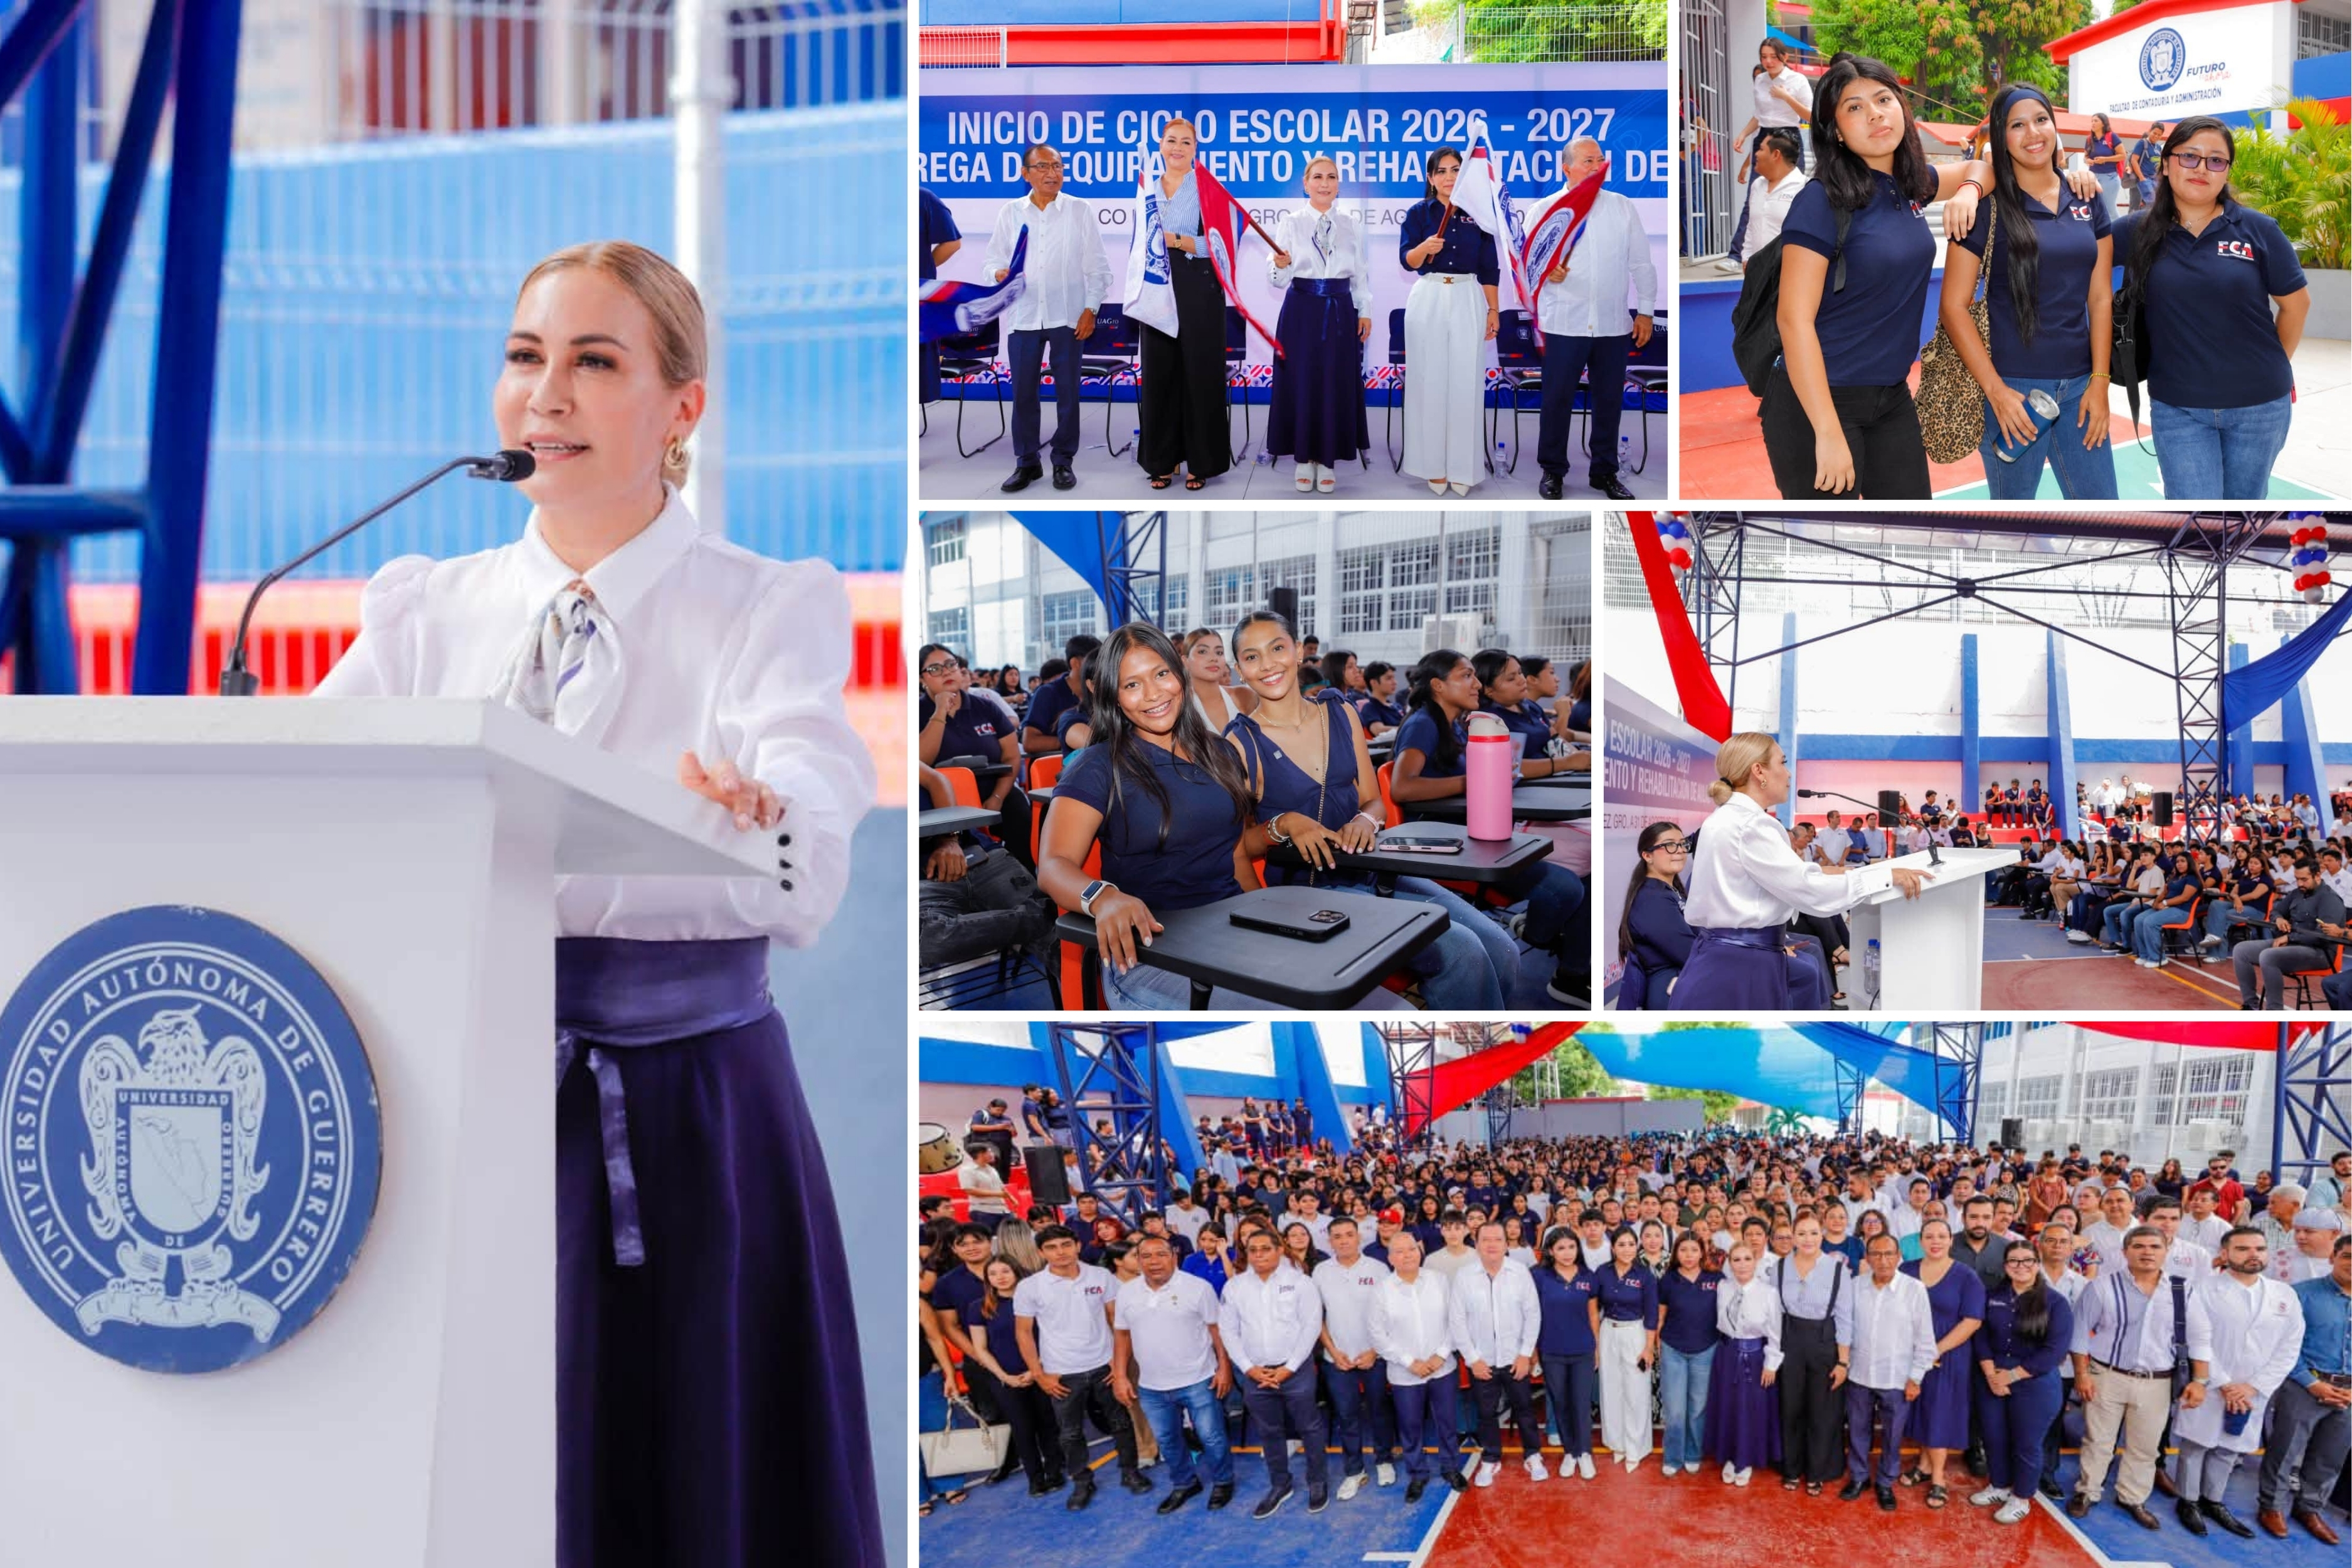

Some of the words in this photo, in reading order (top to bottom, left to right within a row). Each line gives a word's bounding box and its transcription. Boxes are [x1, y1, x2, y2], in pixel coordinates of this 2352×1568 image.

[2186, 61, 2226, 77] FUTURO
[2109, 103, 2130, 114] FACULTAD
[2132, 101, 2138, 110] DE
[2171, 95, 2175, 103] Y
[948, 110, 1049, 144] INICIO
[1062, 110, 1104, 144] DE
[1116, 109, 1217, 144] CICO
[1230, 109, 1389, 143] ESCOLAR
[1402, 109, 1487, 143] 2026
[1527, 108, 1616, 142] 2027
[1003, 152, 1023, 182] D
[1063, 151, 1293, 185] QUIPAENTO
[1336, 149, 1612, 183] REHATACI
[1626, 150, 1668, 182] DE
[2069, 205, 2092, 219] FC
[2218, 241, 2254, 258] FCA
[973, 723, 996, 736] FCA
[1610, 719, 1652, 763] ESCOLAR
[1654, 739, 1671, 769] 2026
[1631, 763, 1637, 792] Y
[1638, 766, 1690, 800] REHABILITACIÓN
[82, 956, 268, 1021] AUTÓNOMA
[275, 1025, 315, 1073] DE
[119, 1091, 230, 1106] UNIVERSIDAD
[16, 1017, 74, 1271] UNIVERSIDAD
[116, 1116, 137, 1223] AUTÓNOMA
[270, 1089, 338, 1285] GUERRERO
[164, 1235, 185, 1247] DE
